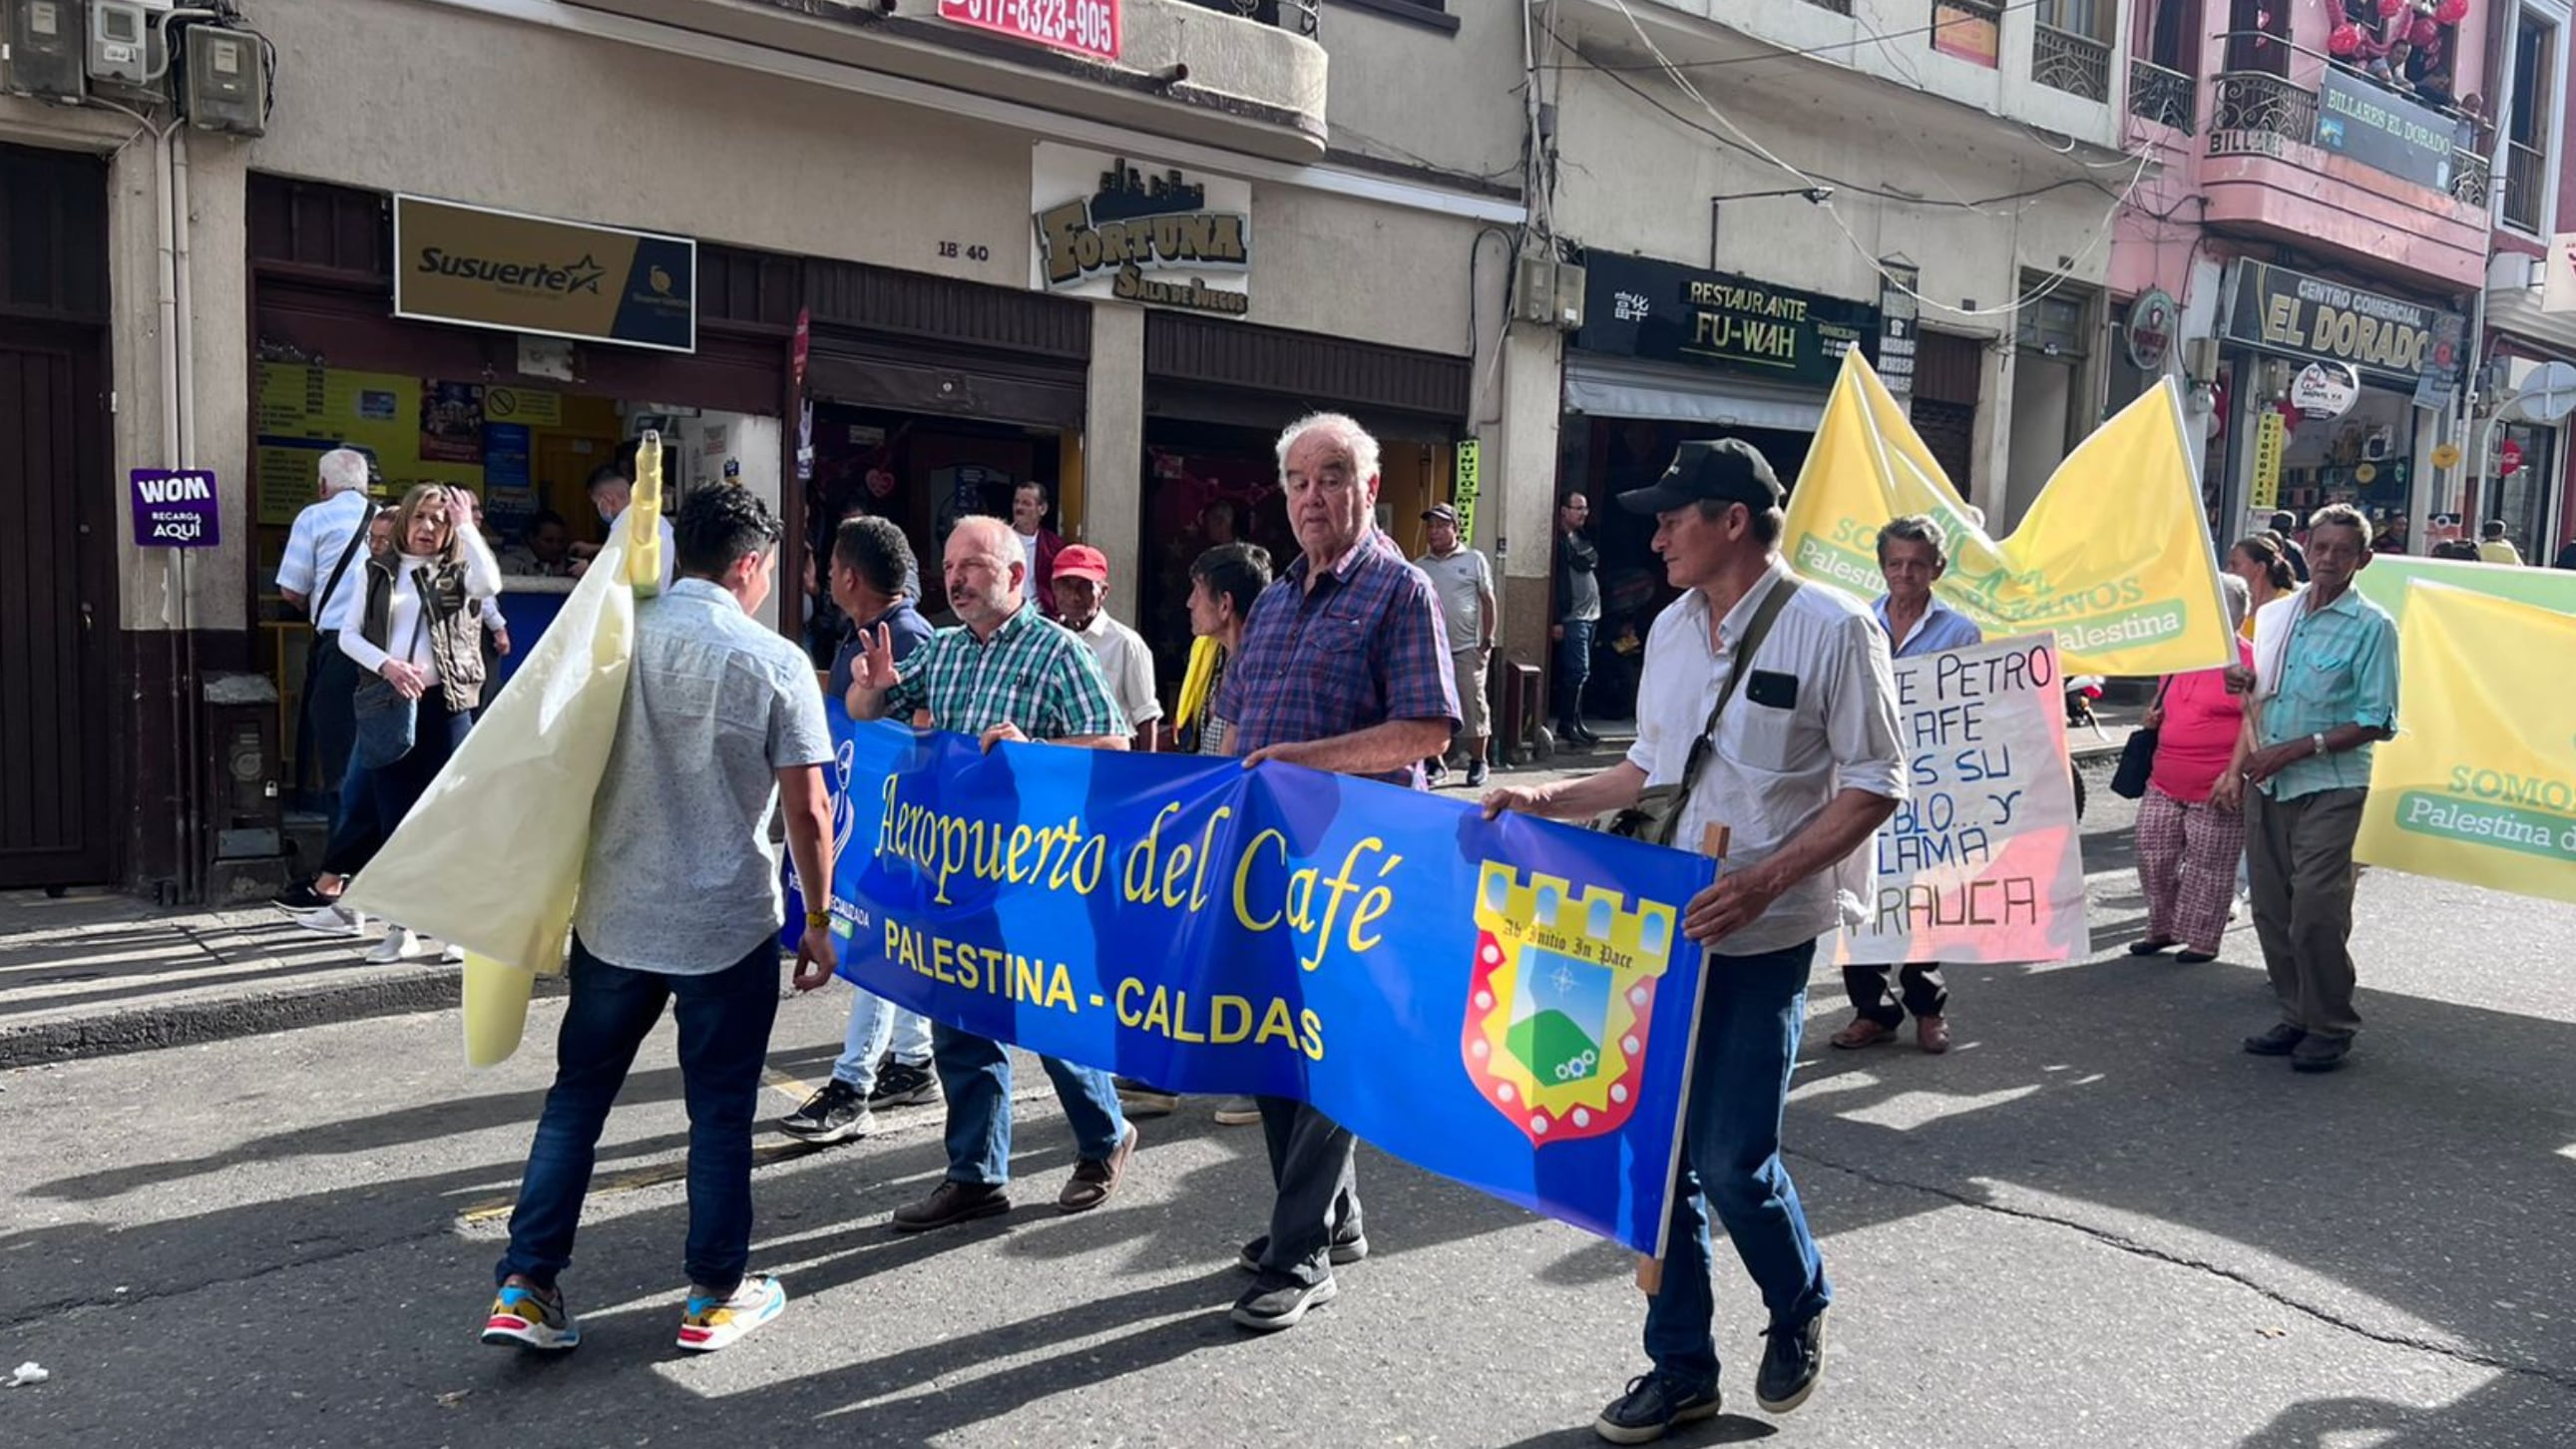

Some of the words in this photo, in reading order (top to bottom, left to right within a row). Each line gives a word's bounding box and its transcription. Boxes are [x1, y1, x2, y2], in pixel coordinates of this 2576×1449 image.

[2328, 89, 2387, 129] BILLARES
[2386, 114, 2402, 137] EL
[2403, 121, 2451, 157] DORADO
[417, 246, 568, 290] Susuerte
[966, 244, 989, 261] 40
[1690, 281, 1808, 322] RESTAURANTE
[2266, 292, 2306, 347] EL
[2297, 279, 2351, 309] CENTRO
[2353, 293, 2421, 326] COMERCIAL
[1696, 311, 1795, 358] FU-WAH
[138, 476, 211, 504] WOM
[1460, 441, 1476, 493] MINUTOS
[152, 512, 202, 521] RECARGA
[1937, 645, 2051, 701] PETRO
[1901, 702, 1985, 748] AFE
[1955, 743, 2011, 781] SU
[2447, 763, 2576, 812] SOMO
[2406, 796, 2552, 847] Palestina
[875, 773, 1106, 905] Aeropuerto
[1124, 800, 1231, 912] del
[1234, 828, 1403, 972] Café
[1571, 936, 1592, 958] In
[1599, 943, 1633, 969] Pace
[884, 917, 1078, 1014] PALESTINA
[1116, 976, 1325, 1062] CALDAS
